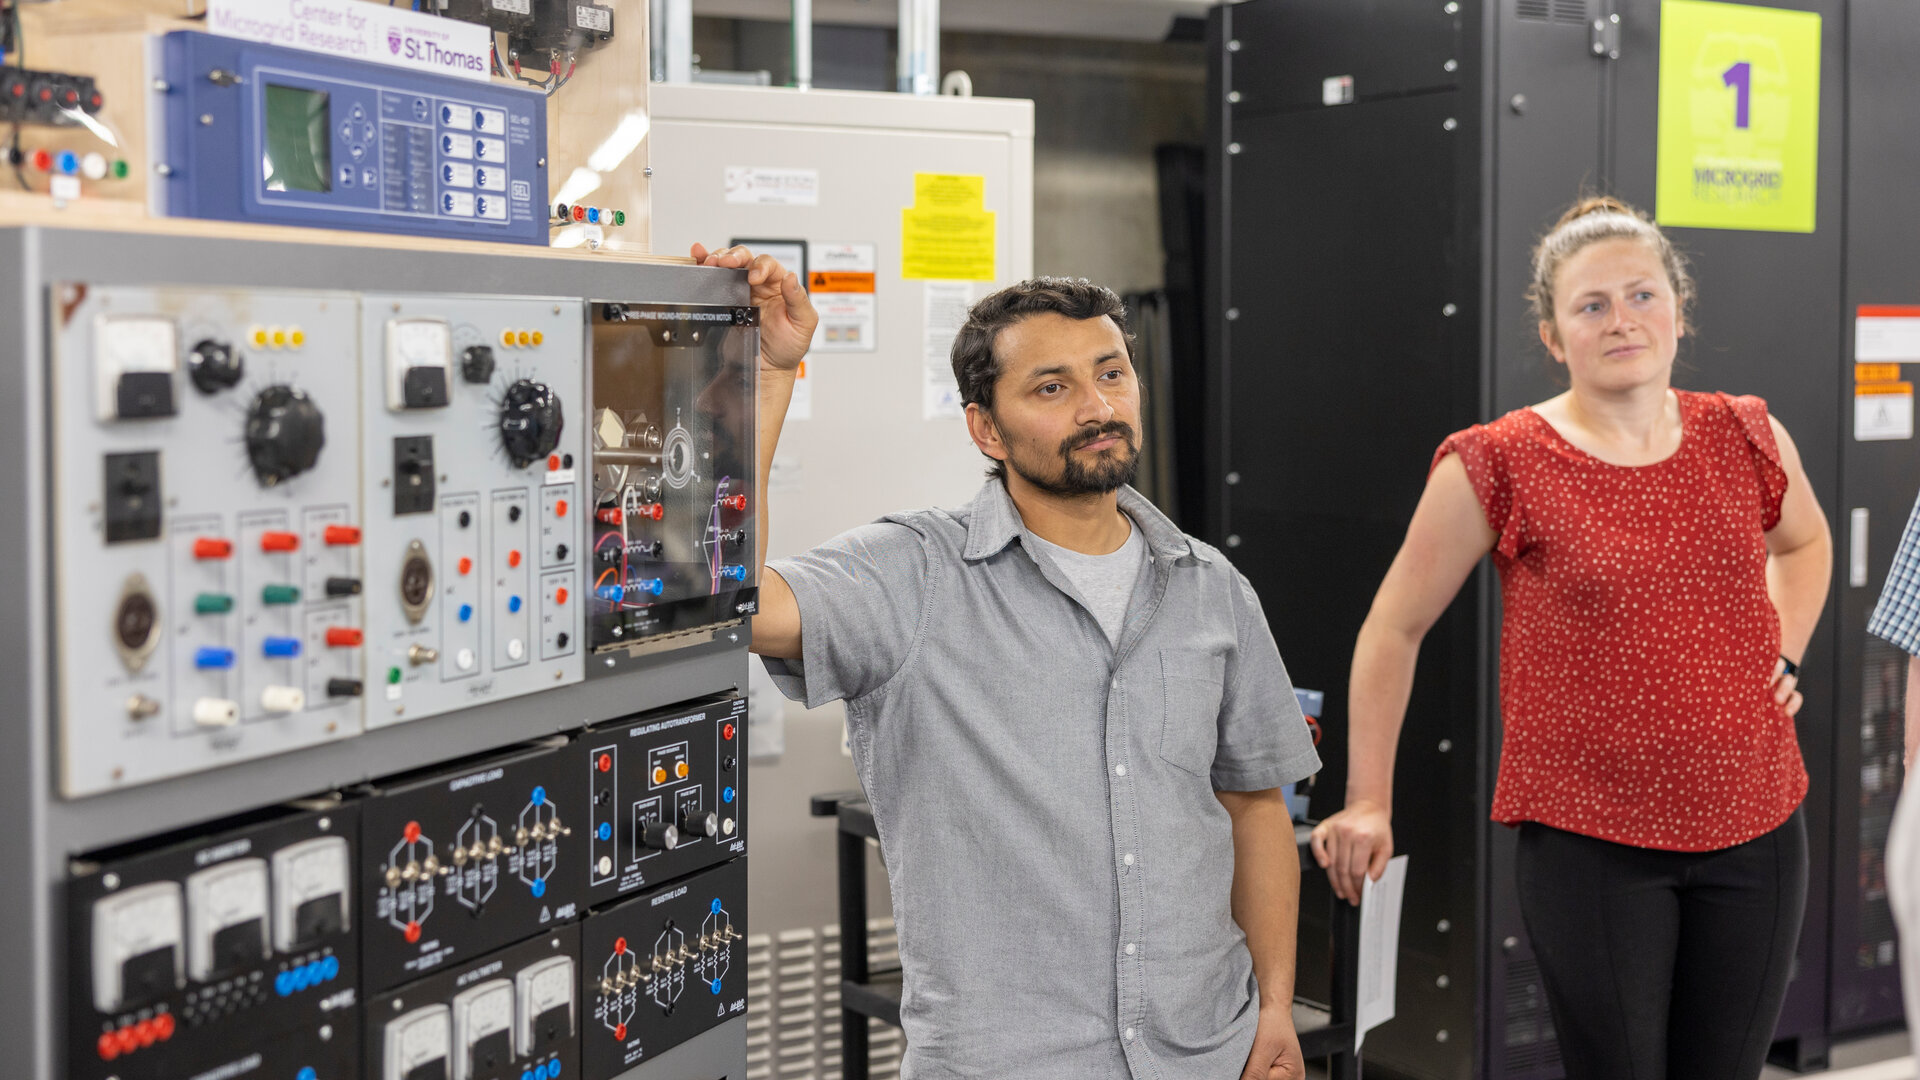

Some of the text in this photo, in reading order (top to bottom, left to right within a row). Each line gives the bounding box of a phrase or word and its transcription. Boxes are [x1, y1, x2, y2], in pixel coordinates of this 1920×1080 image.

[290, 0, 367, 30] Center for
[215, 8, 367, 54] Microgrid Research
[1722, 62, 1750, 129] 1
[1693, 167, 1781, 189] MICROGRID
[657, 311, 692, 320] WOUND-ROTOR
[693, 312, 716, 321] INDUCTION
[716, 313, 732, 321] MOTOR
[629, 712, 706, 737] REGULATING AUTOTRANSFORMER
[651, 885, 688, 906] RESISTIVE LOAD
